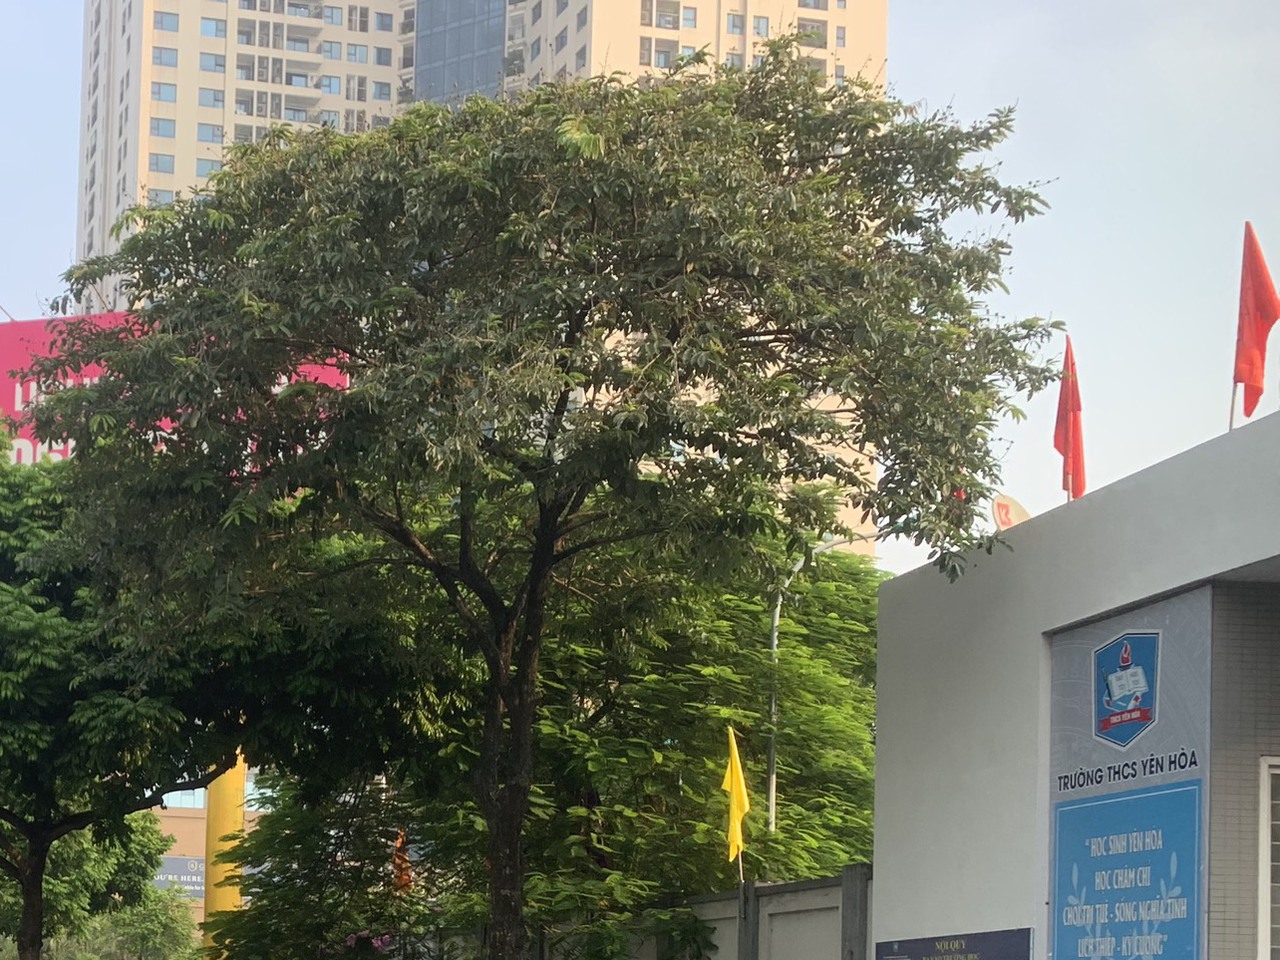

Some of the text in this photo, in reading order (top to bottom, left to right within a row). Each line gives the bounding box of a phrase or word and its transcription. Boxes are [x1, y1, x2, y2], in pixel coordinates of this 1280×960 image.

[1058, 747, 1198, 792] TRƯỜNG THCS YÊN HÒA
[1108, 833, 1128, 855] SINH
[1128, 828, 1144, 853] YÊN
[1144, 825, 1163, 851] HÒA
